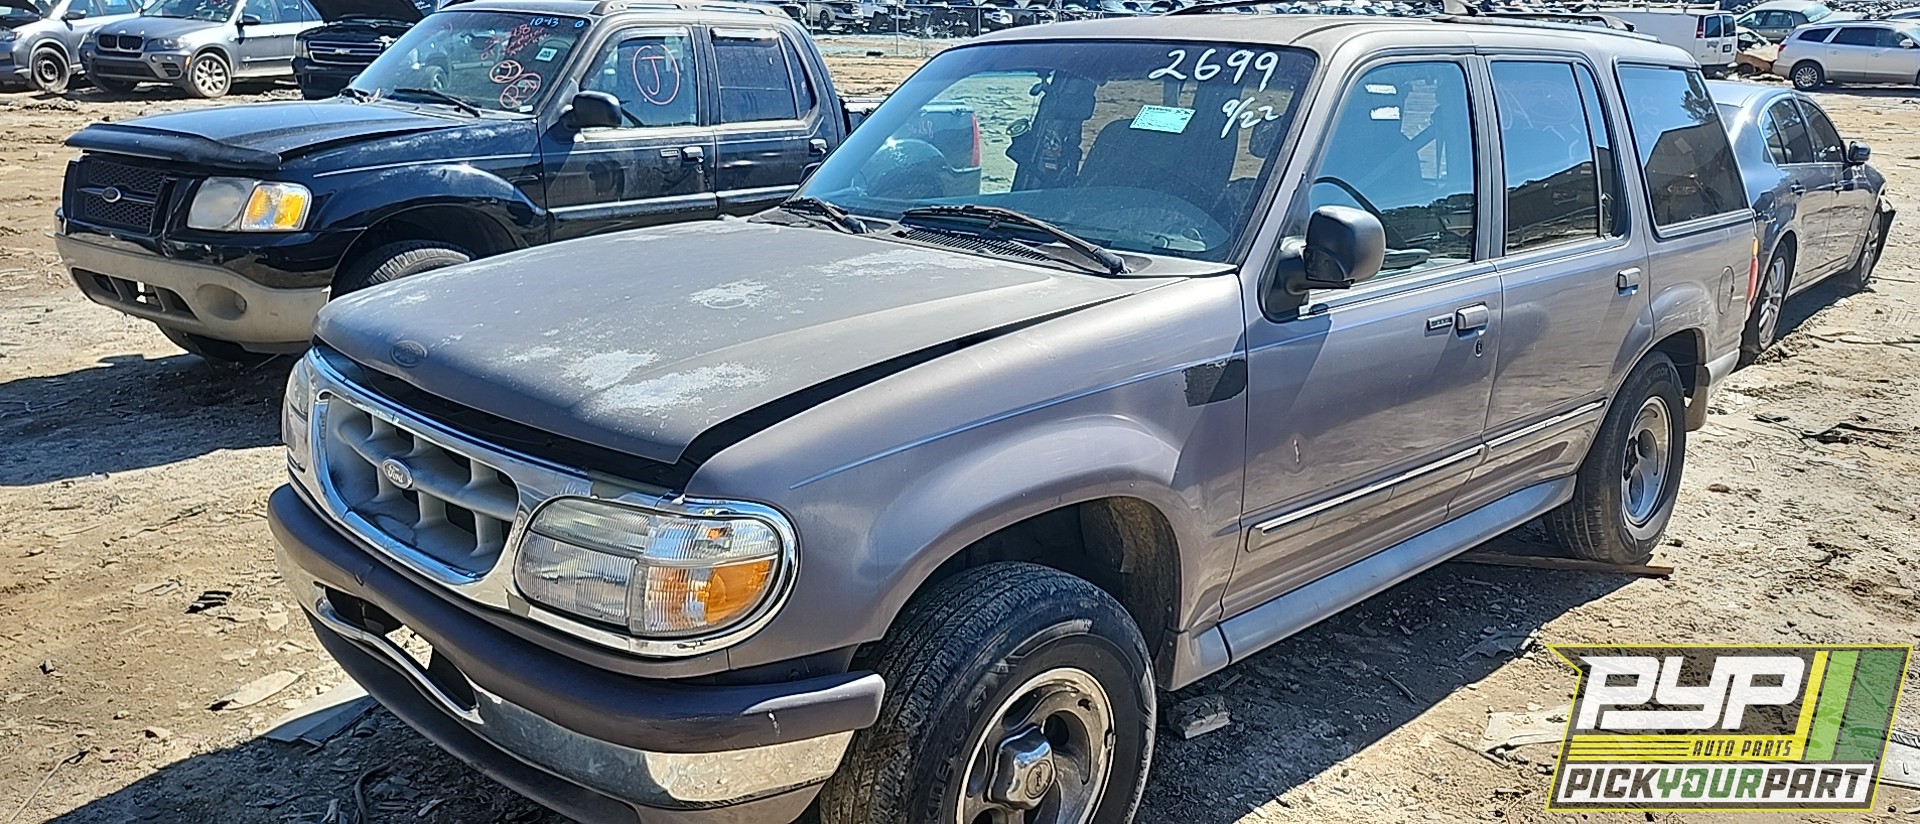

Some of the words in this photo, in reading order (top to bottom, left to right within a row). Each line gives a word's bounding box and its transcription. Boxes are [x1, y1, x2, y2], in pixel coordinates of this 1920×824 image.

[641, 55, 665, 95] J
[1148, 48, 1279, 92] 2699
[1220, 97, 1284, 138] 9/22
[387, 464, 404, 484] Ford
